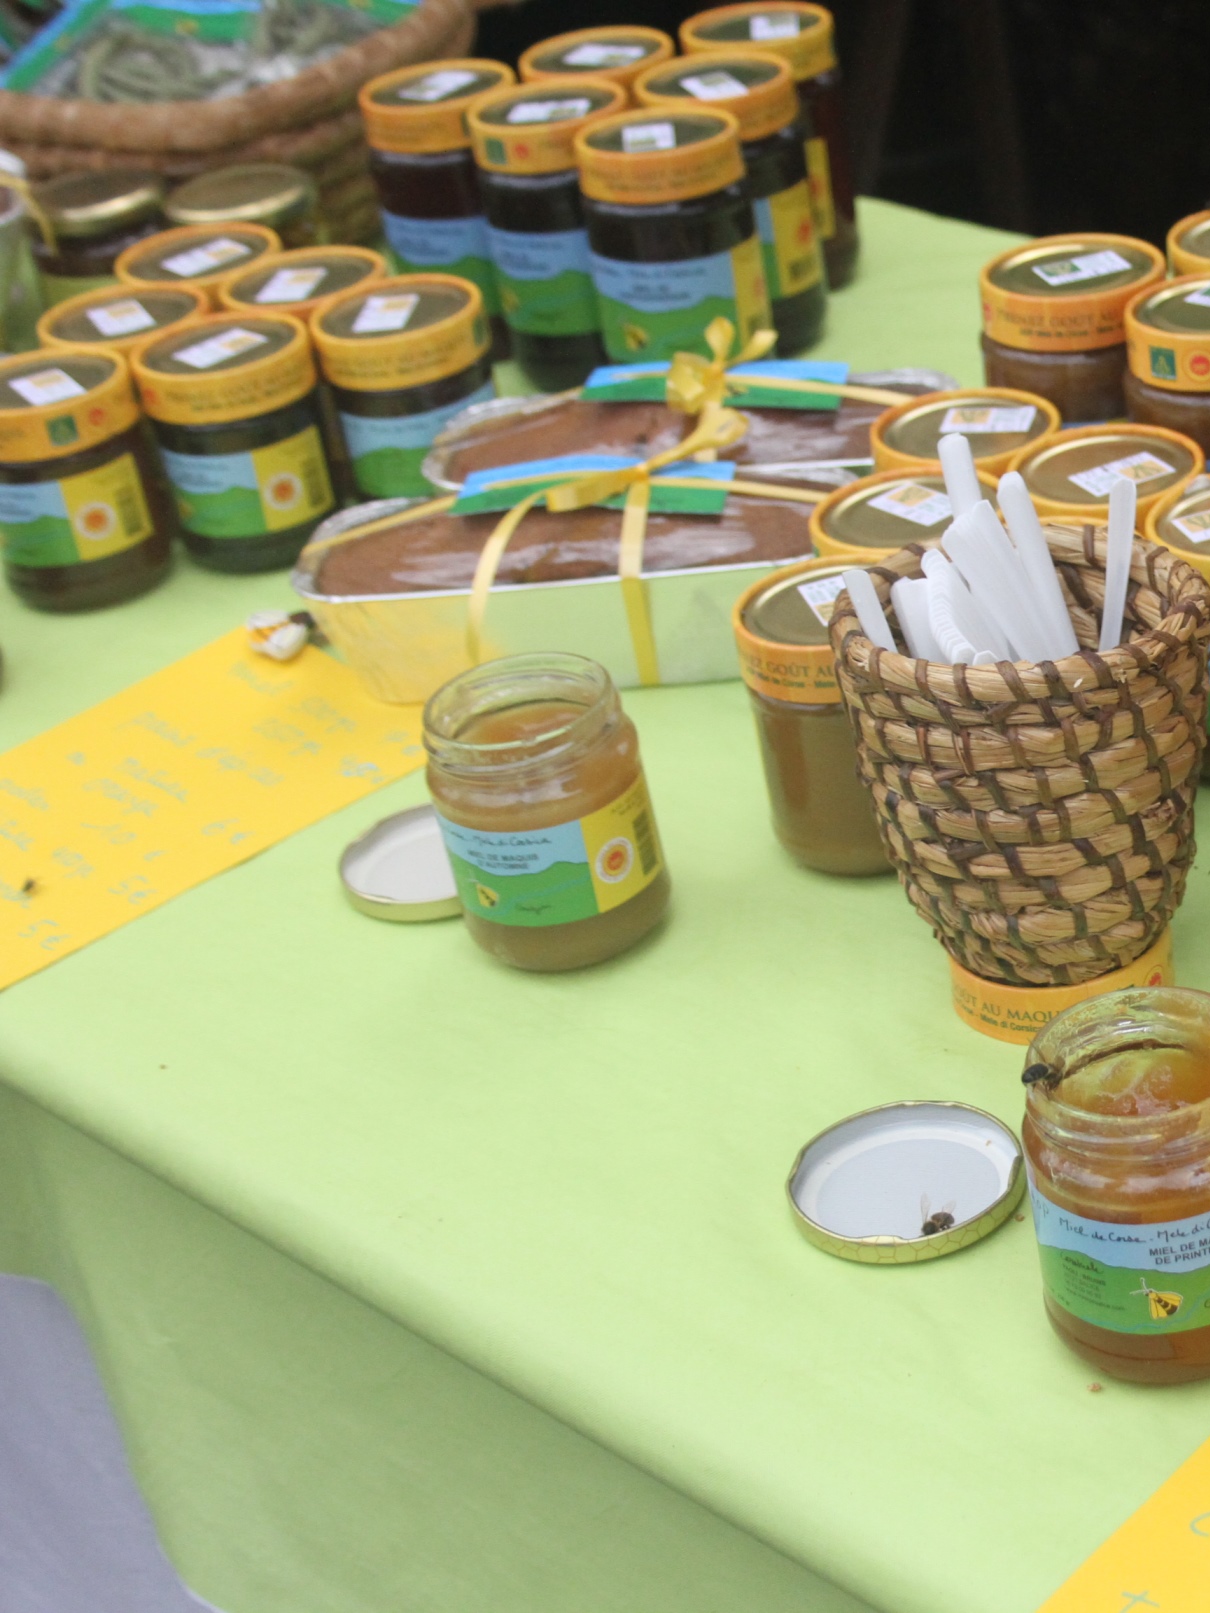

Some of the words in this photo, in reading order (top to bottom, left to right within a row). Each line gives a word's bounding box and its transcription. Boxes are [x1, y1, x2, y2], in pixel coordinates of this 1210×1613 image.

[982, 1003, 1001, 1017] AU
[1149, 1245, 1175, 1257] MIEL
[1180, 1241, 1196, 1252] DE
[1154, 1257, 1171, 1266] DE
